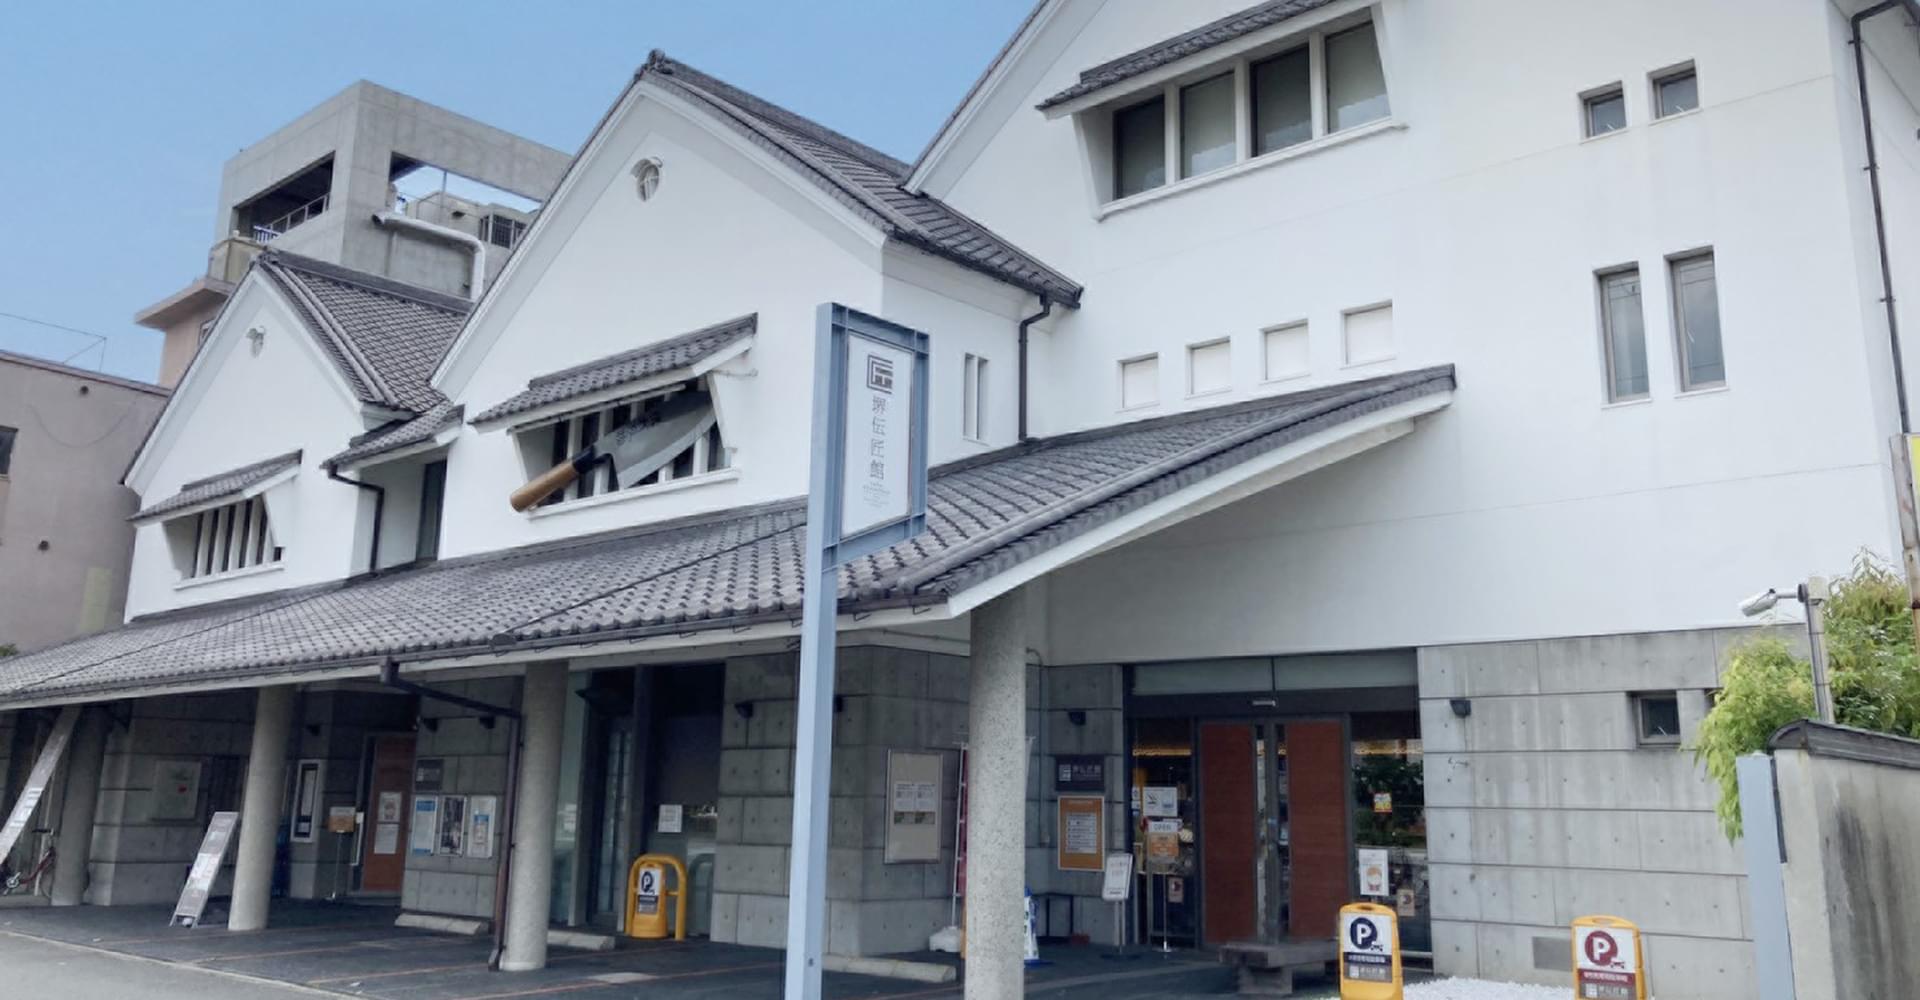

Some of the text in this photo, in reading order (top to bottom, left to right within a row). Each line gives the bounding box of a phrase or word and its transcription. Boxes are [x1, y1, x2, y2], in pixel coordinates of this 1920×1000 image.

[870, 395, 886, 480] 堺伝匠館
[1356, 923, 1372, 945] P
[1593, 937, 1611, 960] P
